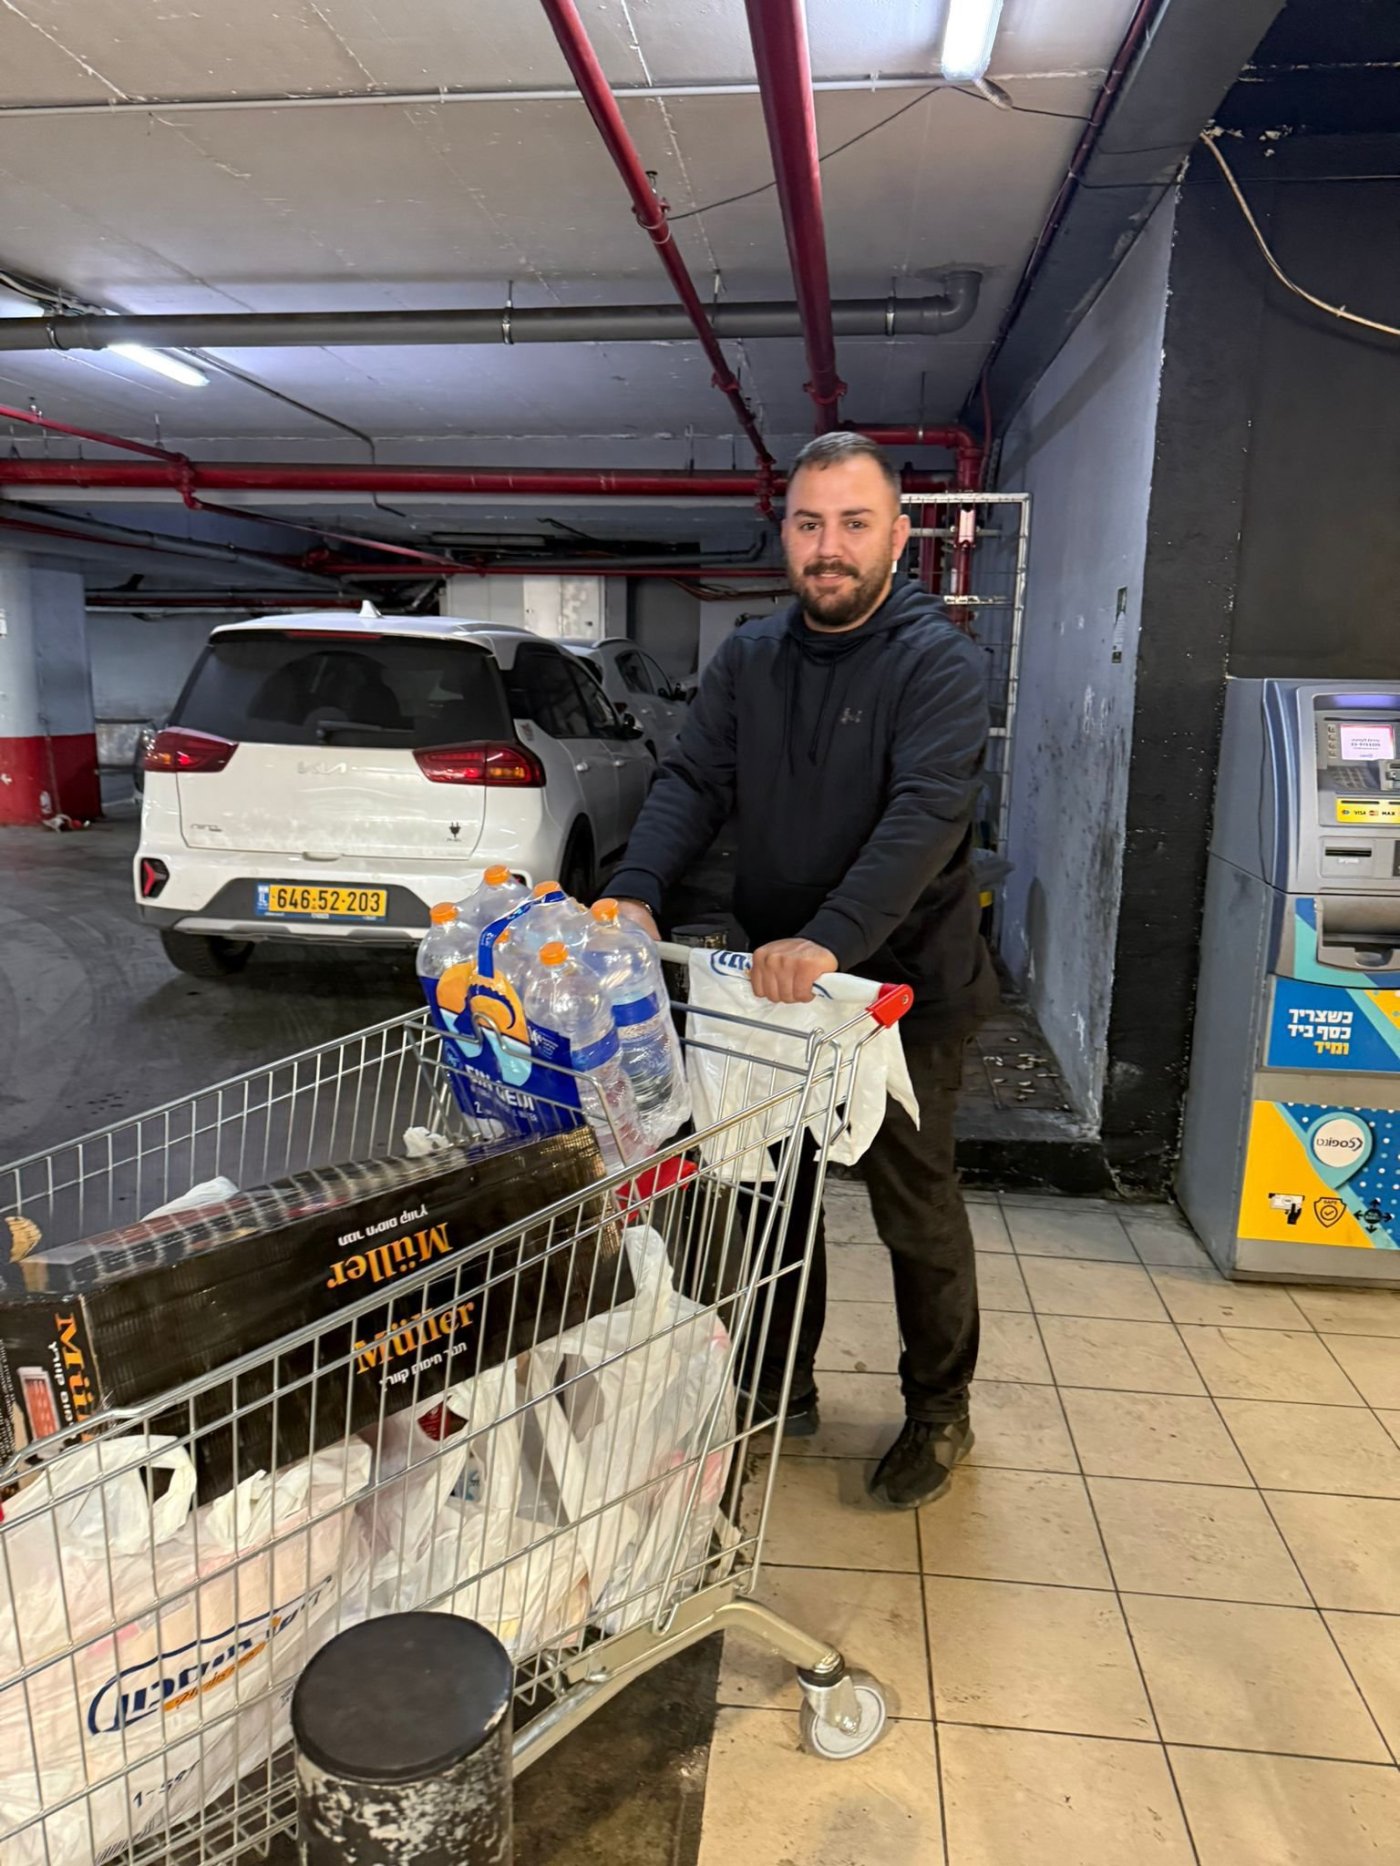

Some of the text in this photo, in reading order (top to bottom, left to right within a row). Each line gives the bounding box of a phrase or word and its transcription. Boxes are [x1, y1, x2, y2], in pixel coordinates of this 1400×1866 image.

[1288, 1008, 1354, 1025] כשצריך
[1287, 1024, 1352, 1041] כסף ביד
[1313, 1040, 1350, 1056] ומיד
[338, 1203, 429, 1247] תנור חימום קוורץ
[326, 1221, 455, 1289] Müller
[354, 1301, 475, 1375] Müller
